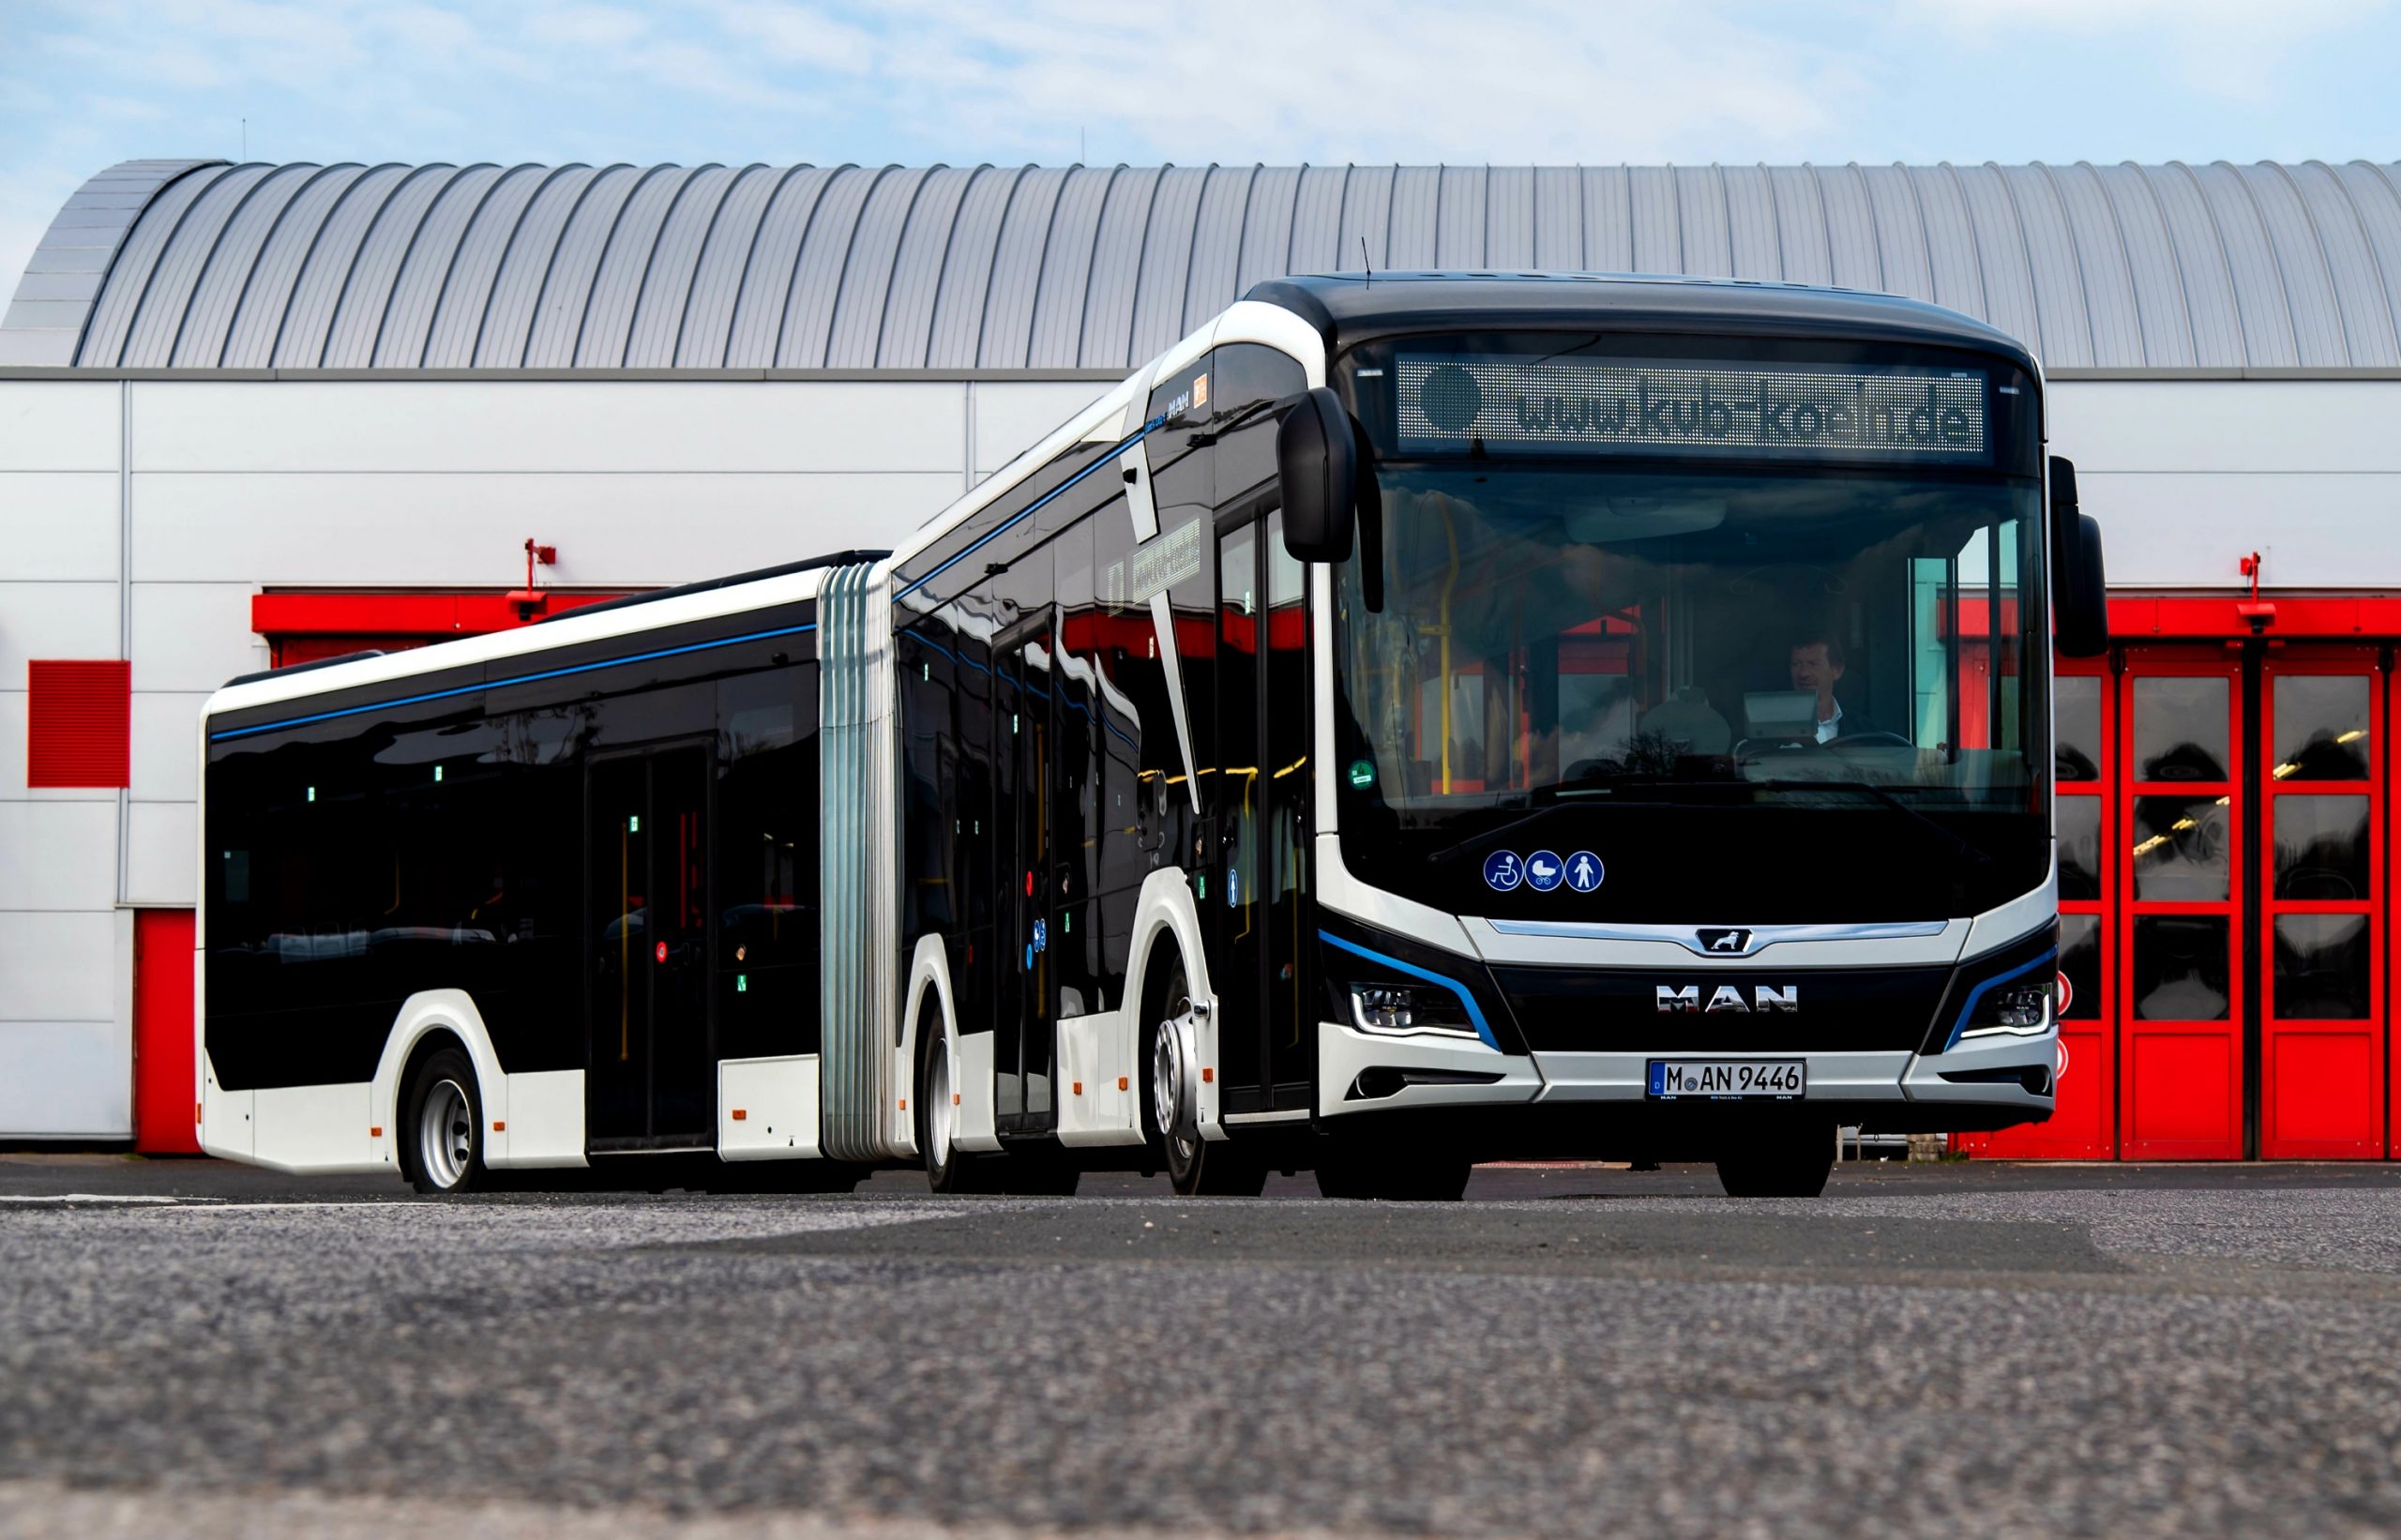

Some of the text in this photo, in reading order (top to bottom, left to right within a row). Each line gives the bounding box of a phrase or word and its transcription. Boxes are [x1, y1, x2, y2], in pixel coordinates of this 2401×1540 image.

[1656, 986, 1798, 1013] MAN
[1654, 1081, 1662, 1090] D
[1666, 1066, 1799, 1091] M AN 9446
